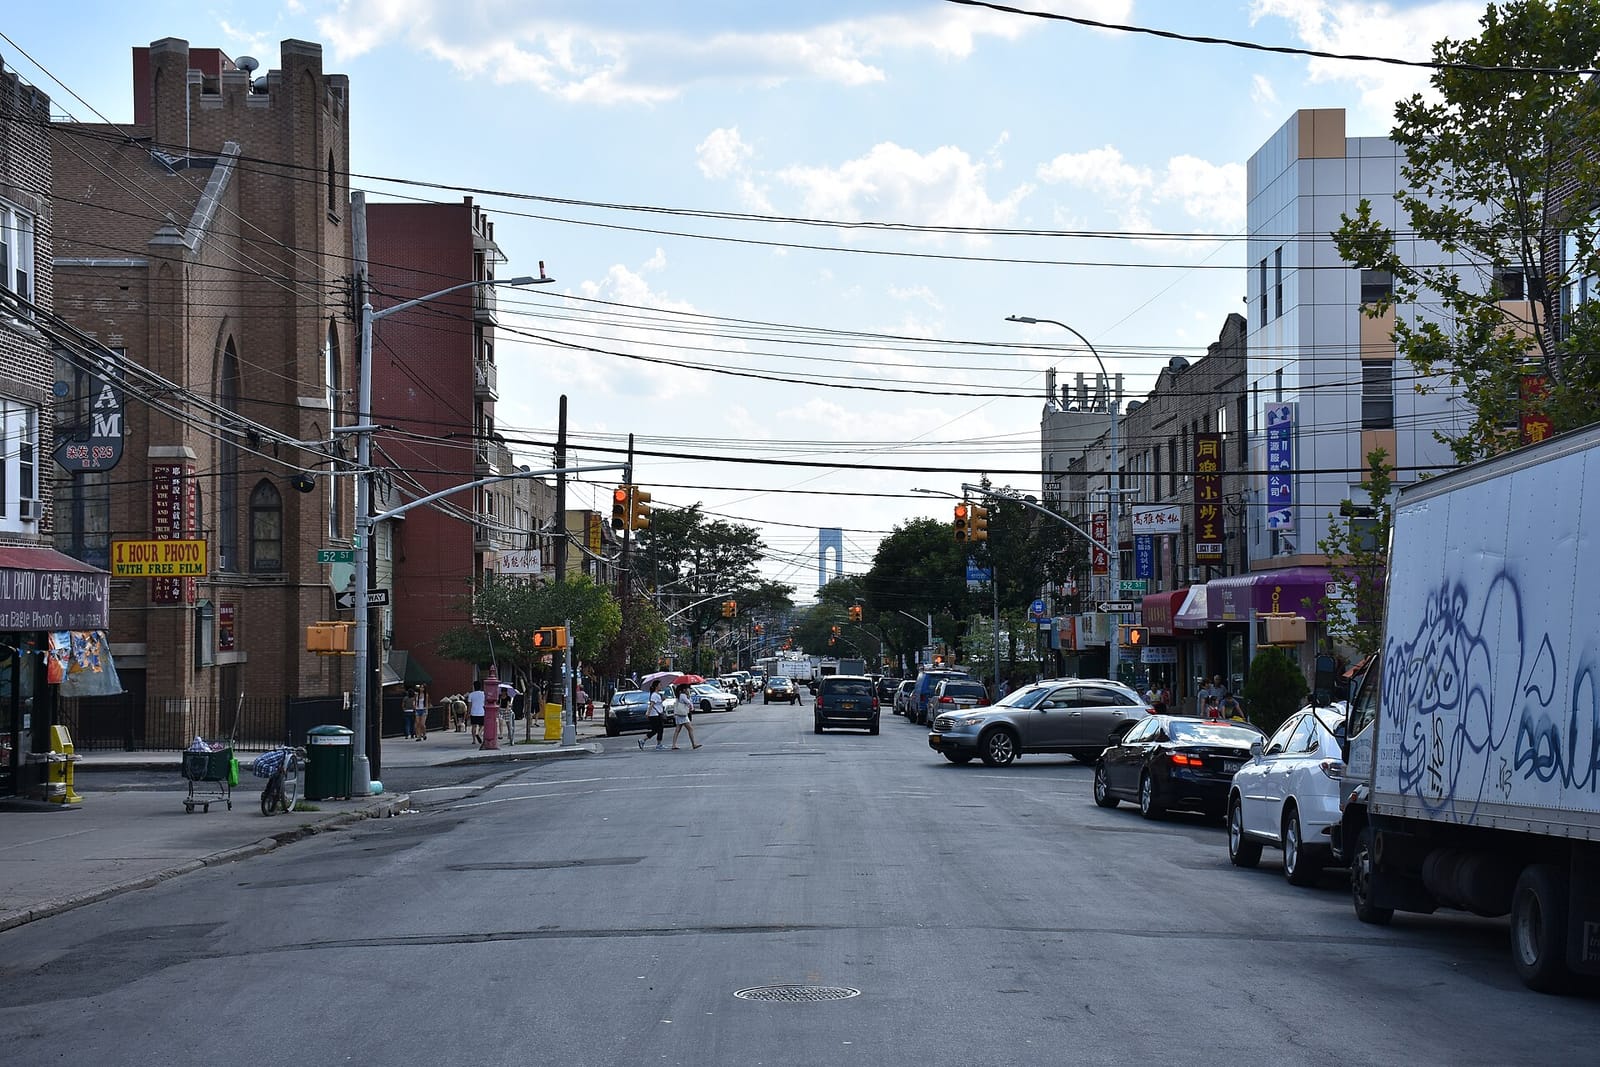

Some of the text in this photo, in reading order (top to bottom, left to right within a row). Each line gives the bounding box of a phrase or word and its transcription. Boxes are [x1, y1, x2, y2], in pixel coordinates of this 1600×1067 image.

[1197, 440, 1218, 539] 同樂小炒王
[116, 543, 200, 563] 1 HOUR PHOTO
[323, 551, 349, 562] 52 ST
[117, 563, 202, 574] WITH FREE FILM
[13, 571, 36, 600] PHOTO
[1123, 581, 1132, 590] 52
[368, 593, 383, 603] WAY
[10, 611, 31, 628] Eagle
[32, 611, 53, 628] Photo
